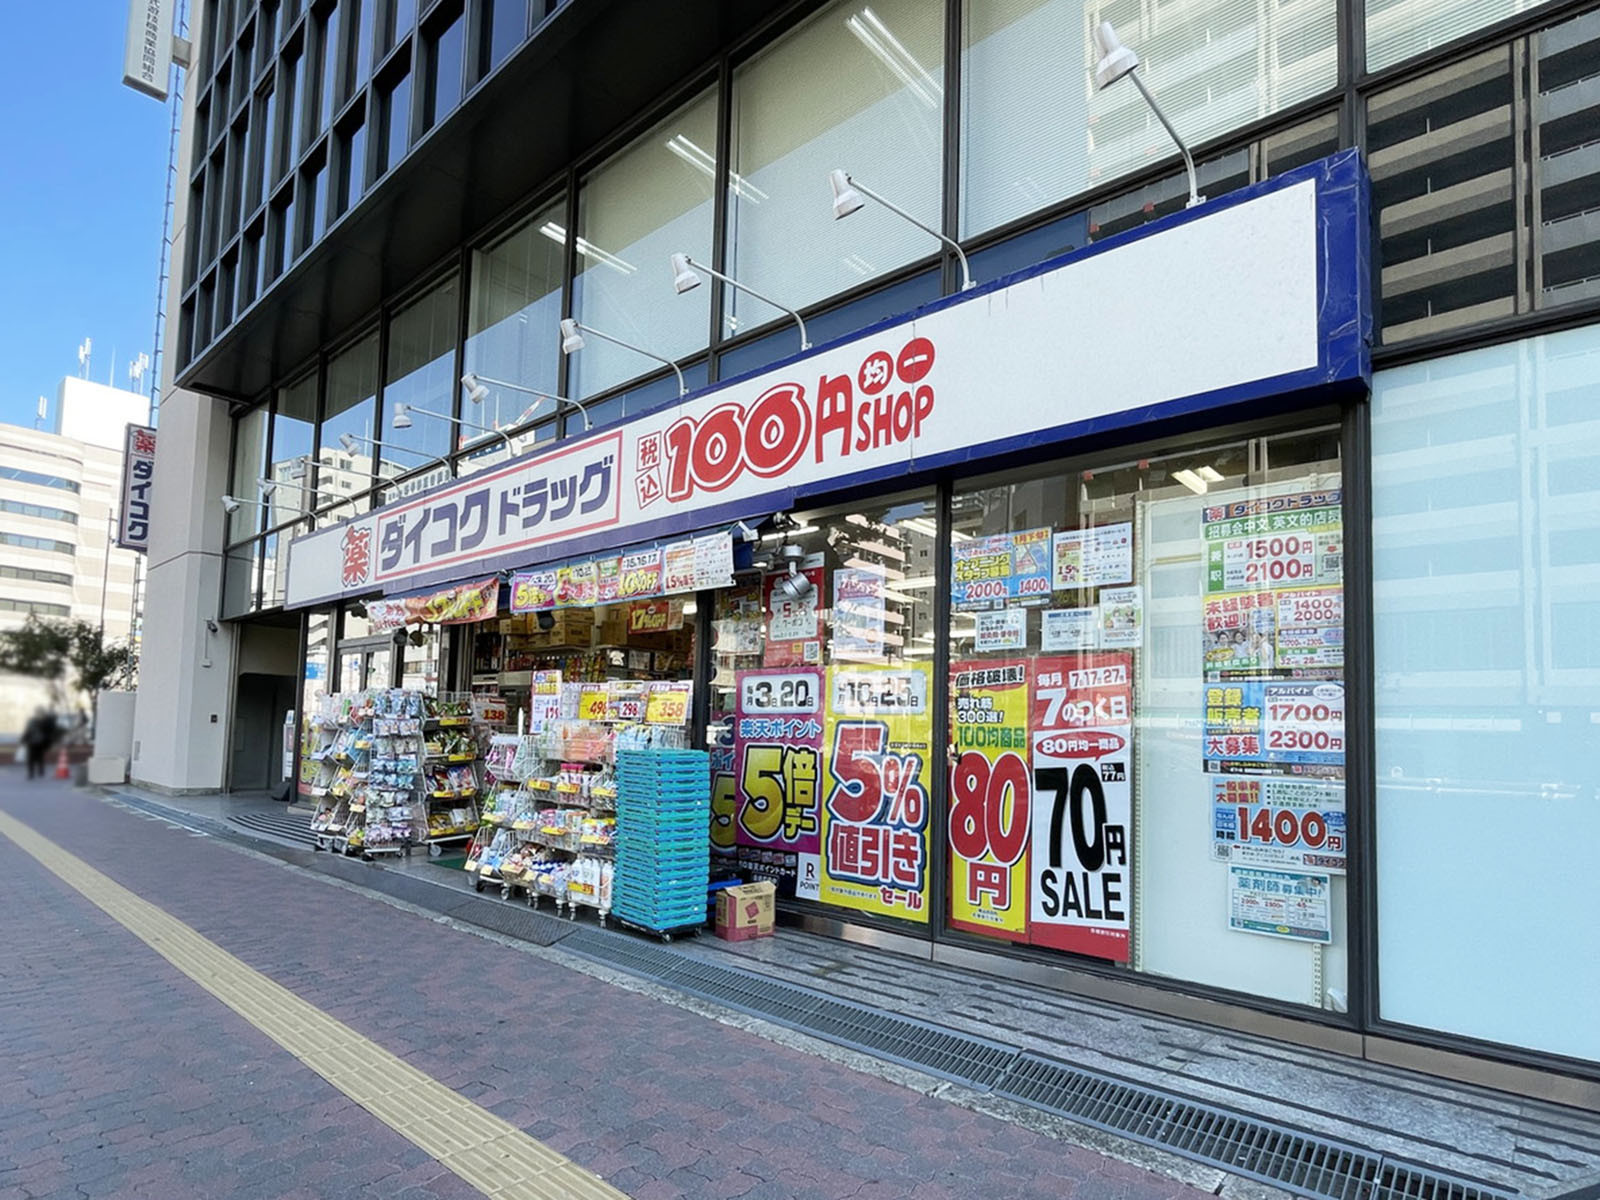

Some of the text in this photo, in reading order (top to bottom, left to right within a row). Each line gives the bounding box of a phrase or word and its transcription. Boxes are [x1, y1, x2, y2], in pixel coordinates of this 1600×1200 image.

[861, 347, 931, 391] 均一
[855, 385, 935, 452] SHOP
[636, 431, 663, 508] 税込
[128, 459, 154, 541] ダイコク
[381, 455, 614, 571] ダイコクドラッグ
[342, 525, 371, 586] 薬
[956, 666, 1025, 687] 価格破壊!
[1270, 687, 1310, 695] アルバイト
[484, 708, 505, 721] 138
[621, 702, 639, 717] 298
[659, 702, 685, 718] 358
[957, 710, 1004, 723] 300選!
[1036, 688, 1128, 726] 7のつく日
[1269, 704, 1342, 721] 1700円
[740, 719, 821, 739] 楽天ポイント
[958, 727, 1026, 748] 100均商品
[1042, 737, 1120, 753] 80円均一商品
[1207, 736, 1259, 755] 大募集
[1269, 730, 1342, 750] 2300円
[829, 726, 923, 824] 5%
[831, 822, 920, 884] 値引き
[799, 881, 819, 891] POINT
[1041, 869, 1126, 921] SALE
[880, 887, 922, 910] セール
